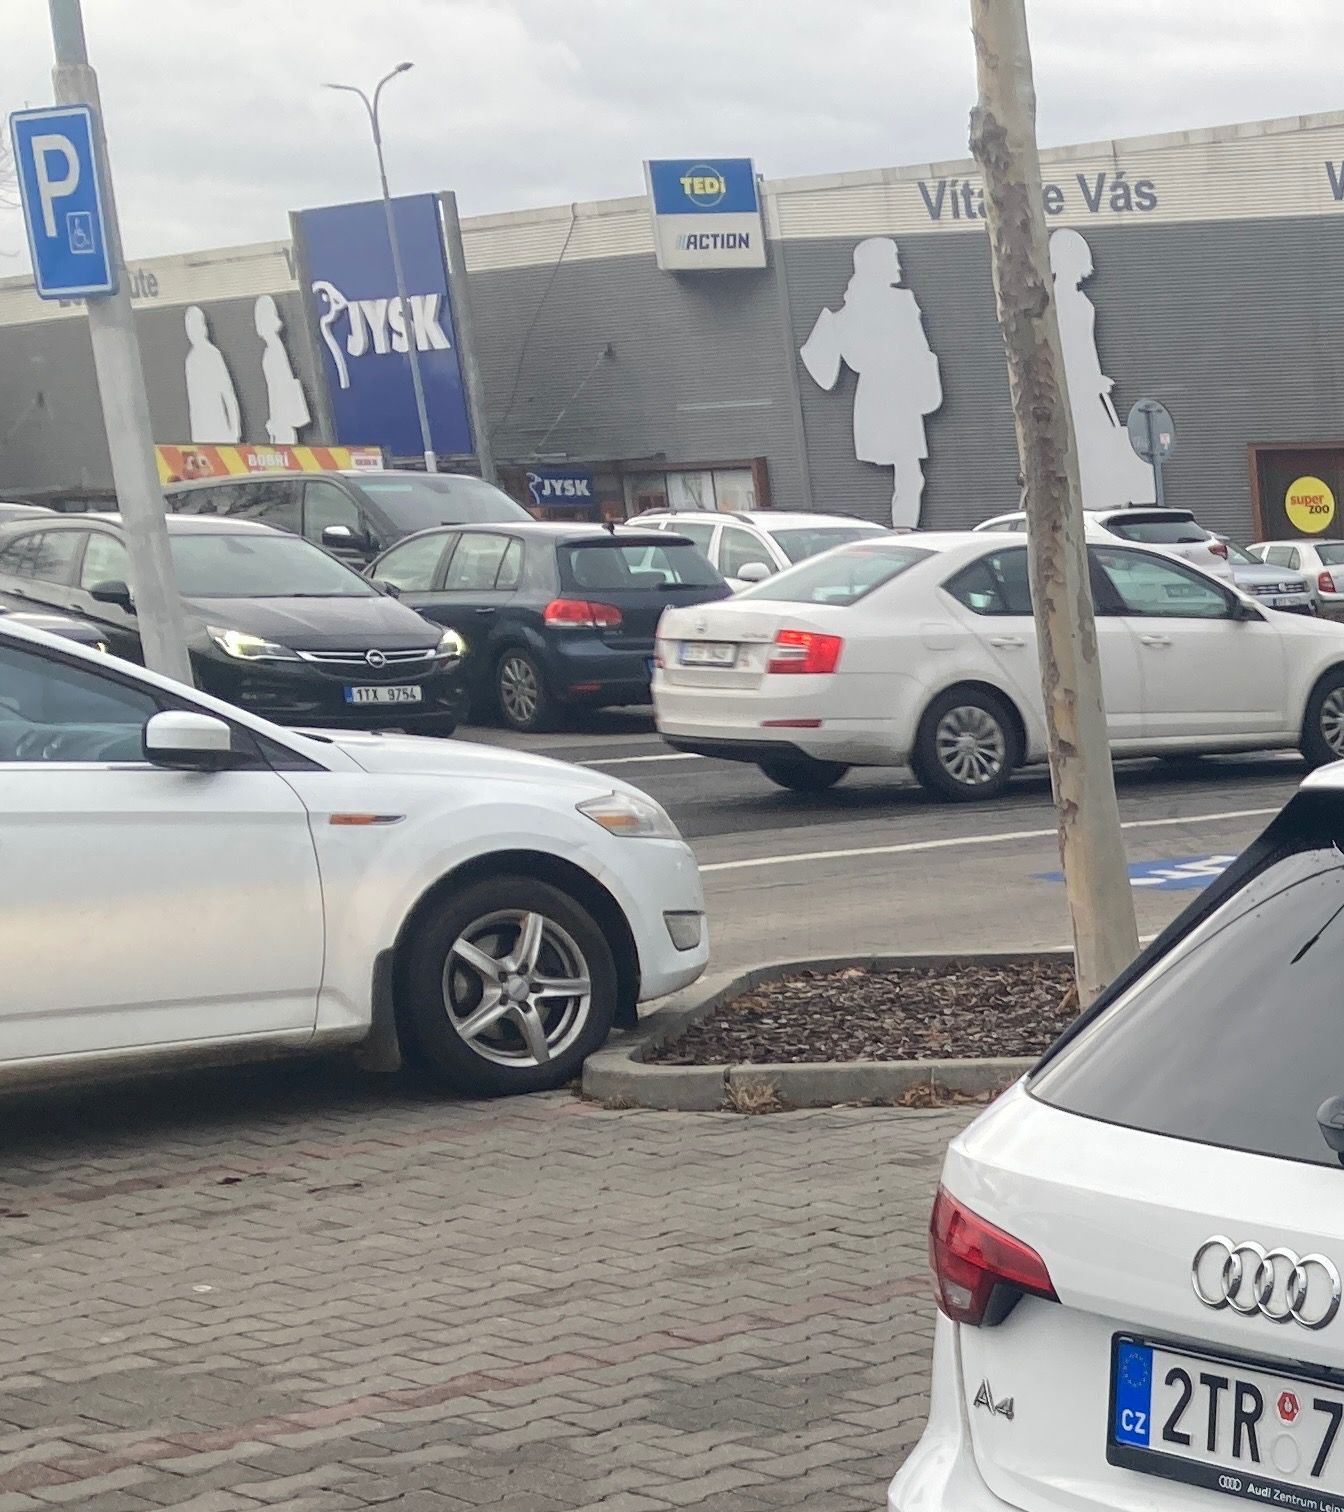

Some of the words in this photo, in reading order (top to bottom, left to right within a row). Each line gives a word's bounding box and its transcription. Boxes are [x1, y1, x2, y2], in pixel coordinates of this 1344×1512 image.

[31, 134, 80, 238] P
[1076, 172, 1158, 213] Vás
[687, 233, 750, 250] ACTION
[347, 293, 451, 357] JYSK
[541, 479, 591, 496] JYSK
[1290, 494, 1324, 507] super
[1309, 504, 1330, 514] zoo
[356, 688, 379, 701] 1TX
[387, 687, 416, 701] 9754
[973, 1377, 1015, 1421] A4
[1121, 1408, 1146, 1435] CZ
[1162, 1367, 1264, 1463] 2TR
[1247, 1482, 1271, 1498] Audi
[1273, 1488, 1318, 1510] Zentrum
